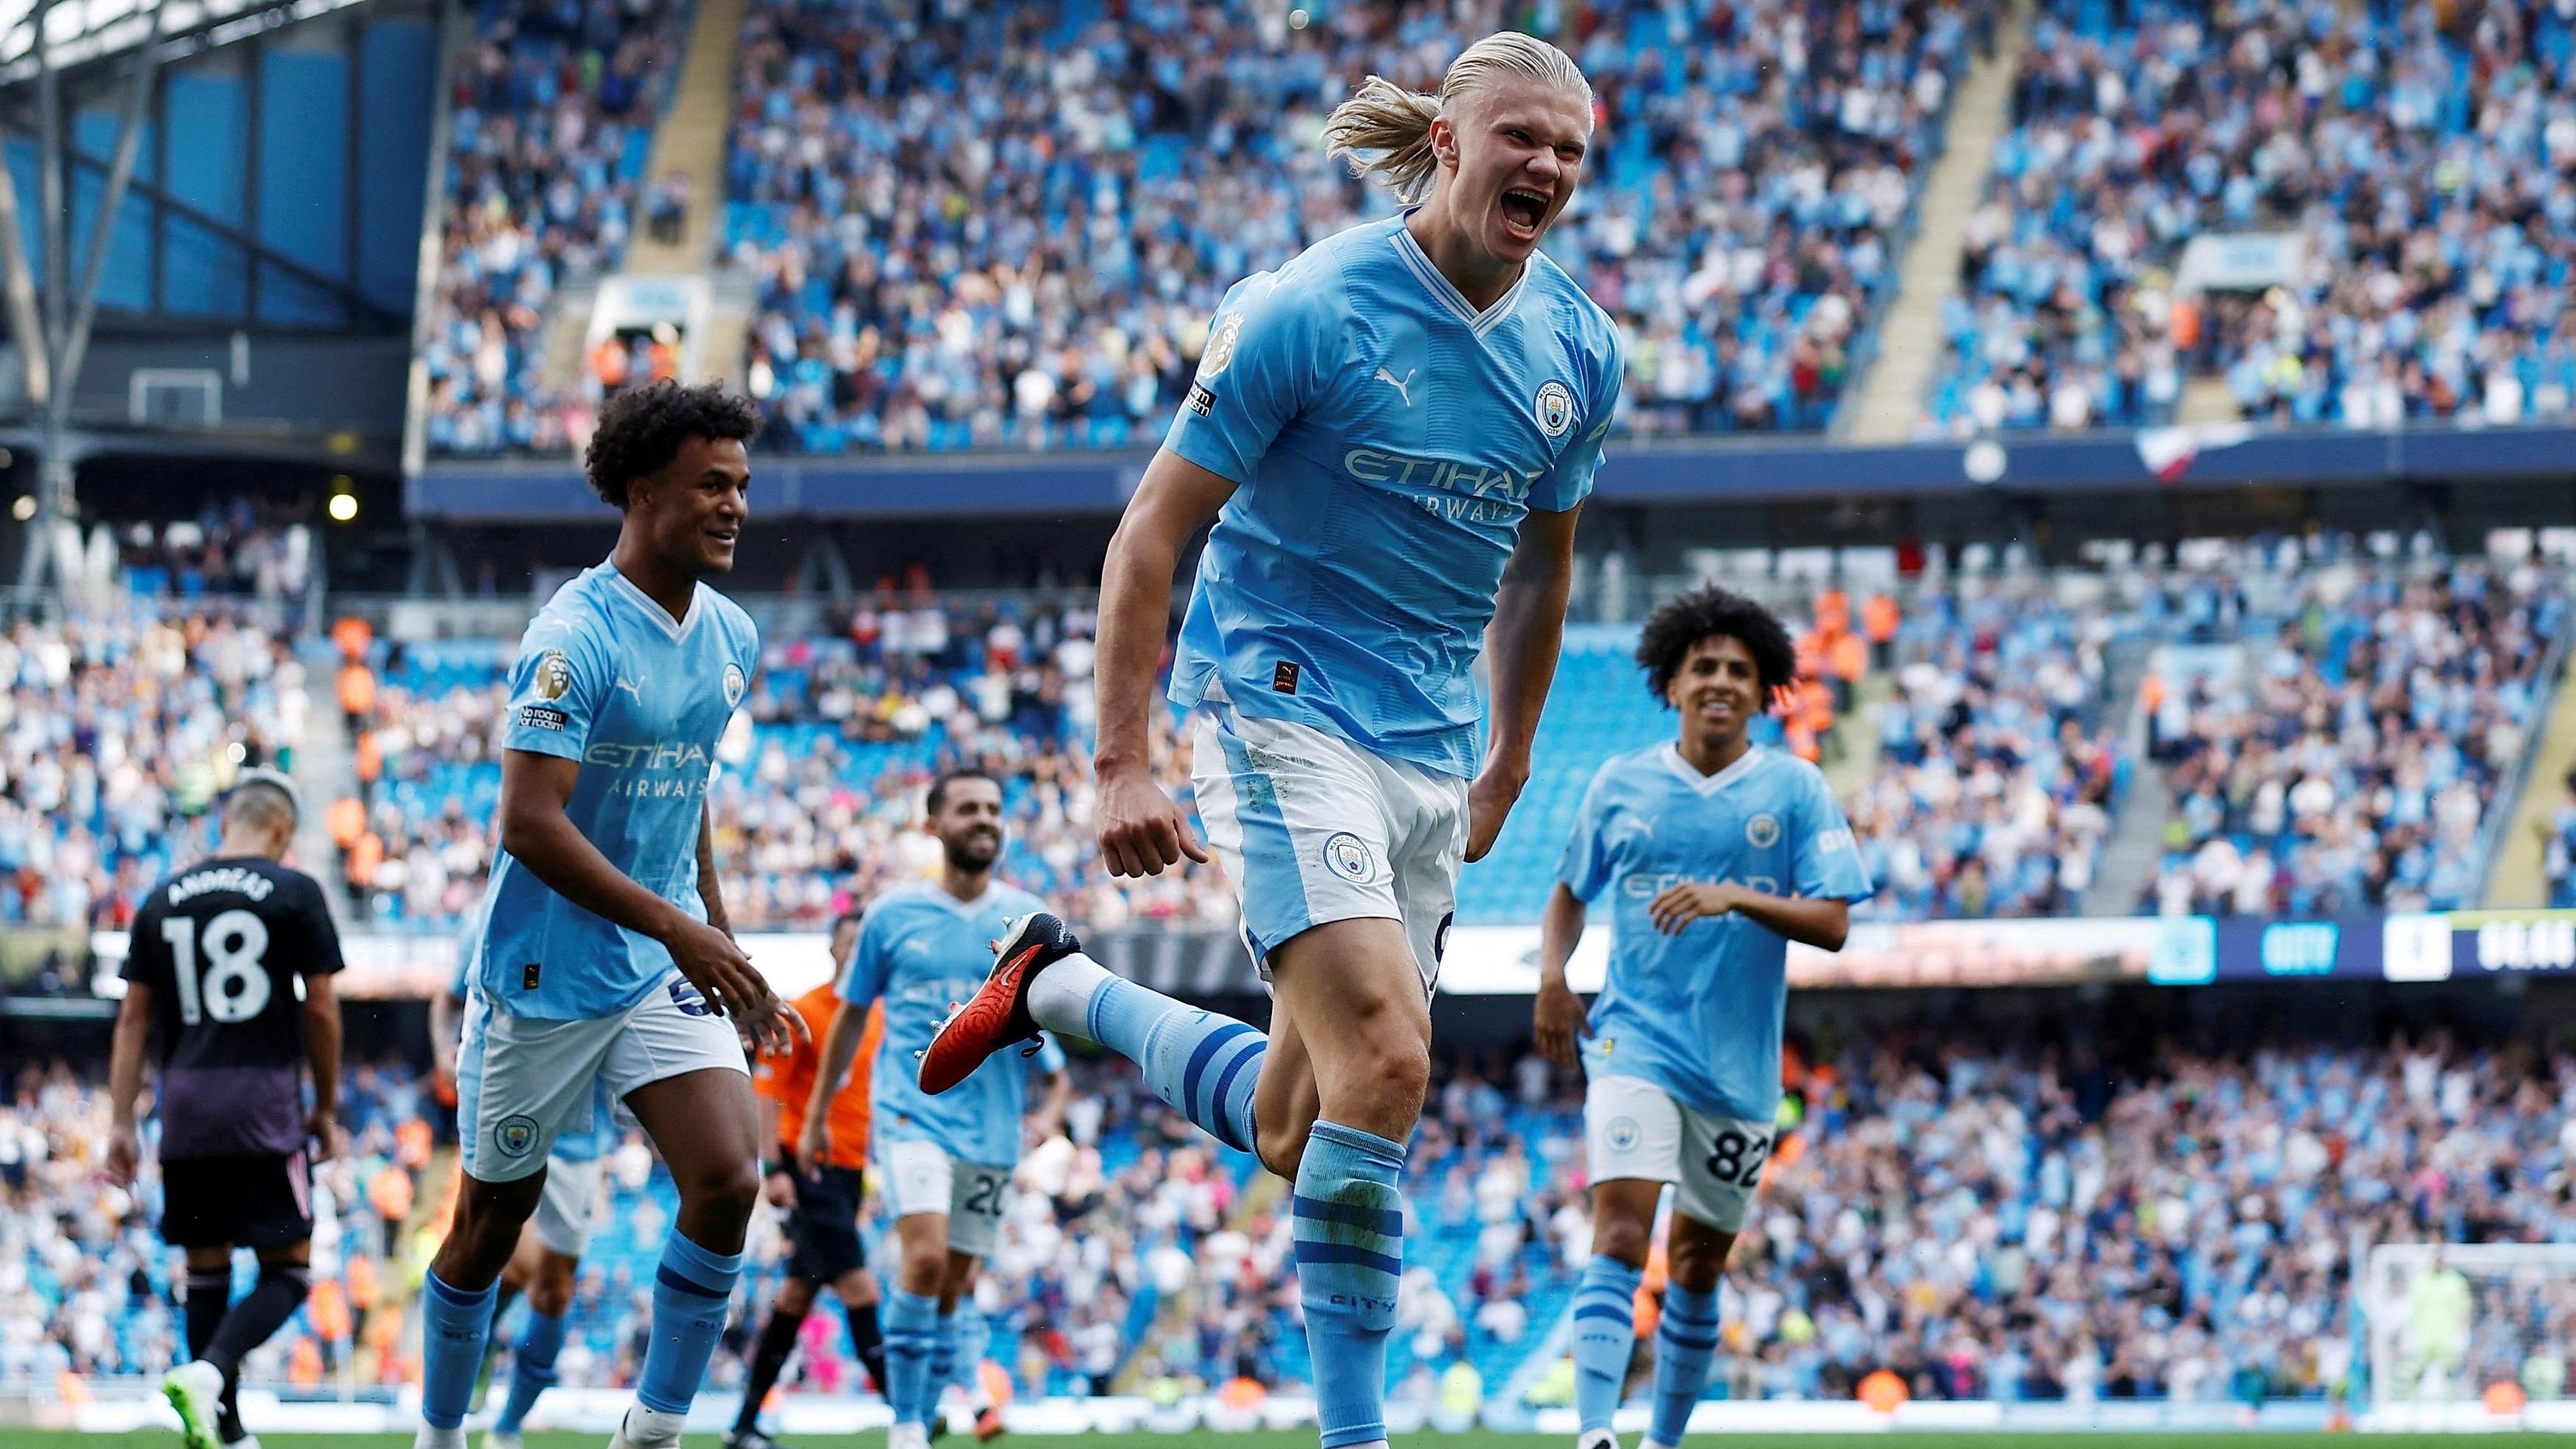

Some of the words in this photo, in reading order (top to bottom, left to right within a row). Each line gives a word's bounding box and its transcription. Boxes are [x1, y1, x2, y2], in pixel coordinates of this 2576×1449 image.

[1538, 384, 1571, 405] MANCHESTER
[1547, 428, 1560, 436] CITY
[520, 706, 534, 718] No
[534, 709, 562, 722] room
[531, 718, 565, 731] racism
[584, 742, 712, 770] ETIHA
[608, 770, 707, 798] AIRWAYS
[1329, 836, 1368, 857] MANCHESTER
[168, 867, 274, 907] ANDREAS
[1348, 874, 1363, 882] CITY
[161, 909, 271, 1025] 18
[1707, 1130, 1768, 1188] 82
[1330, 1294, 1396, 1313] CITY
